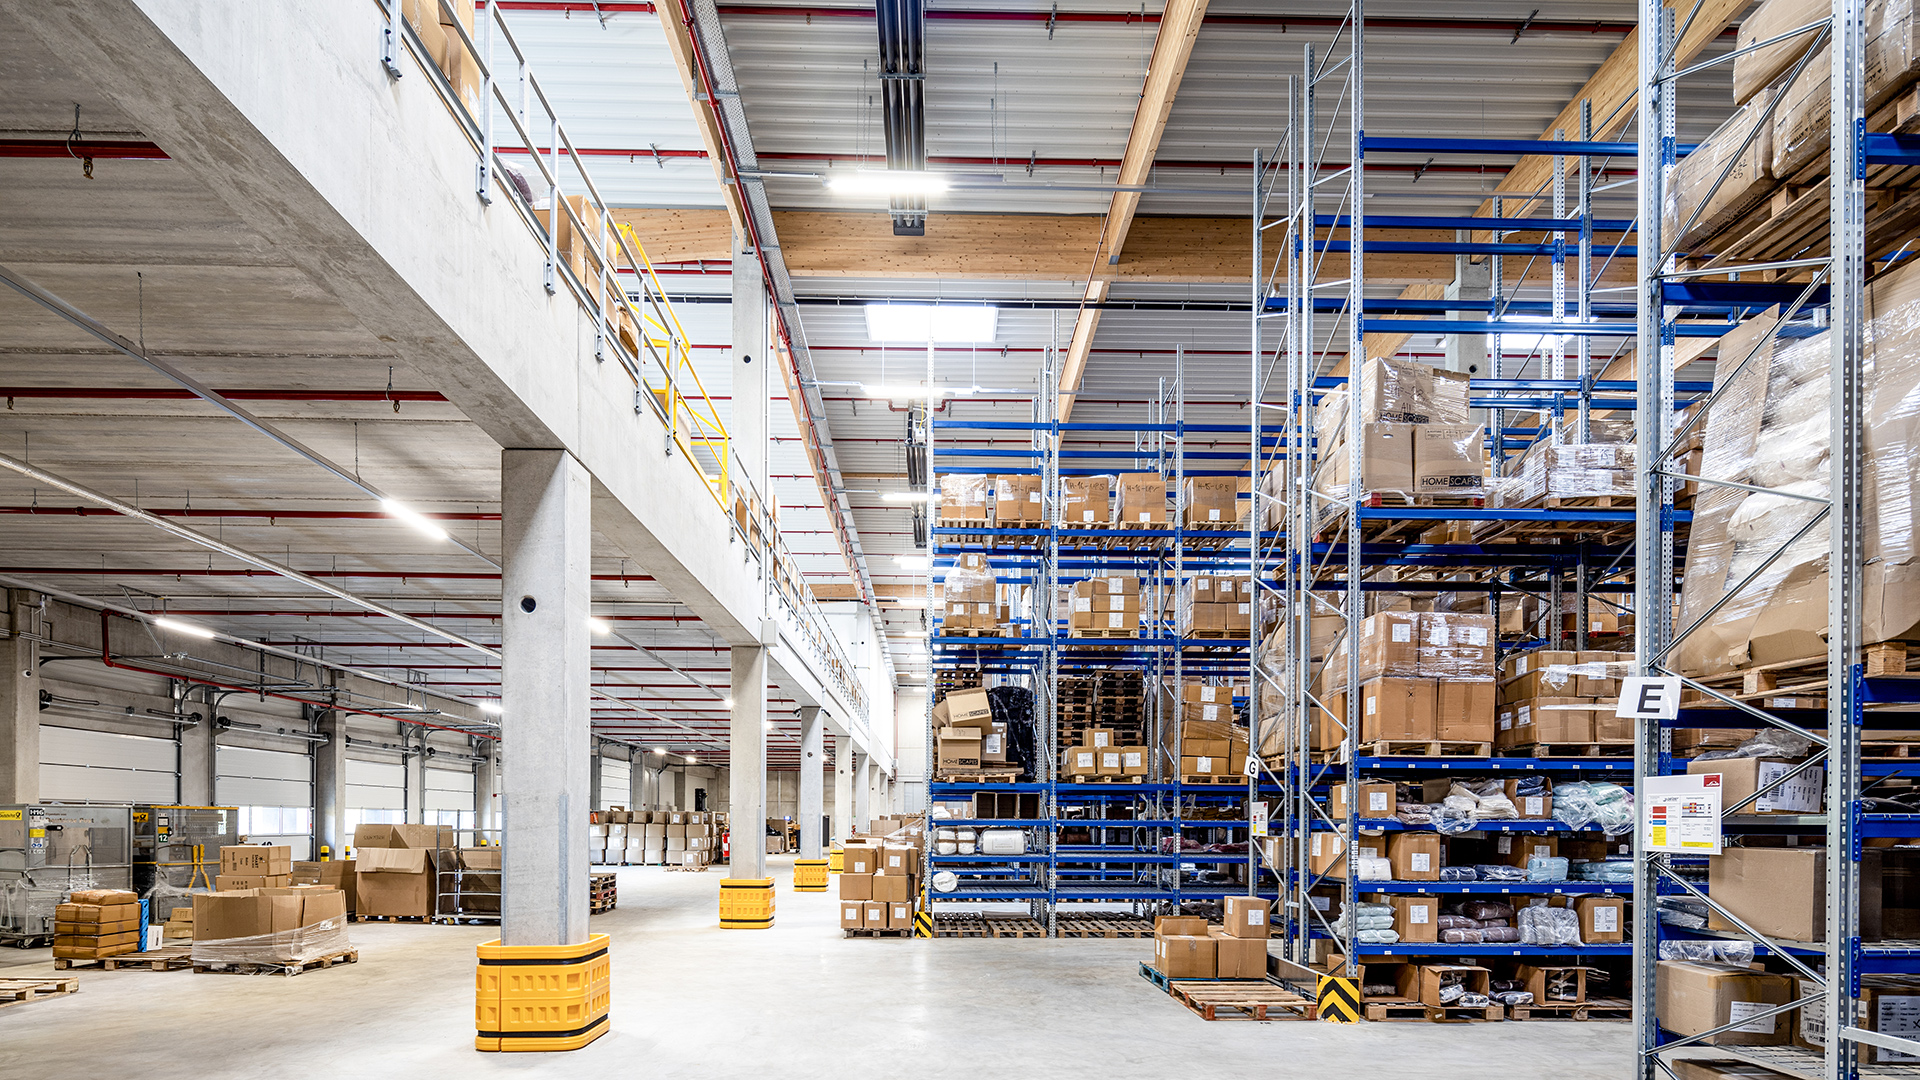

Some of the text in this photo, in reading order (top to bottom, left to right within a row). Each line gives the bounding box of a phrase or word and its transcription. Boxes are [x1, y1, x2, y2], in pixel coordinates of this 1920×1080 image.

[1422, 477, 1481, 486] HOME SCAPES
[1636, 684, 1665, 713] E
[1248, 761, 1257, 775] G
[159, 834, 168, 842] 12
